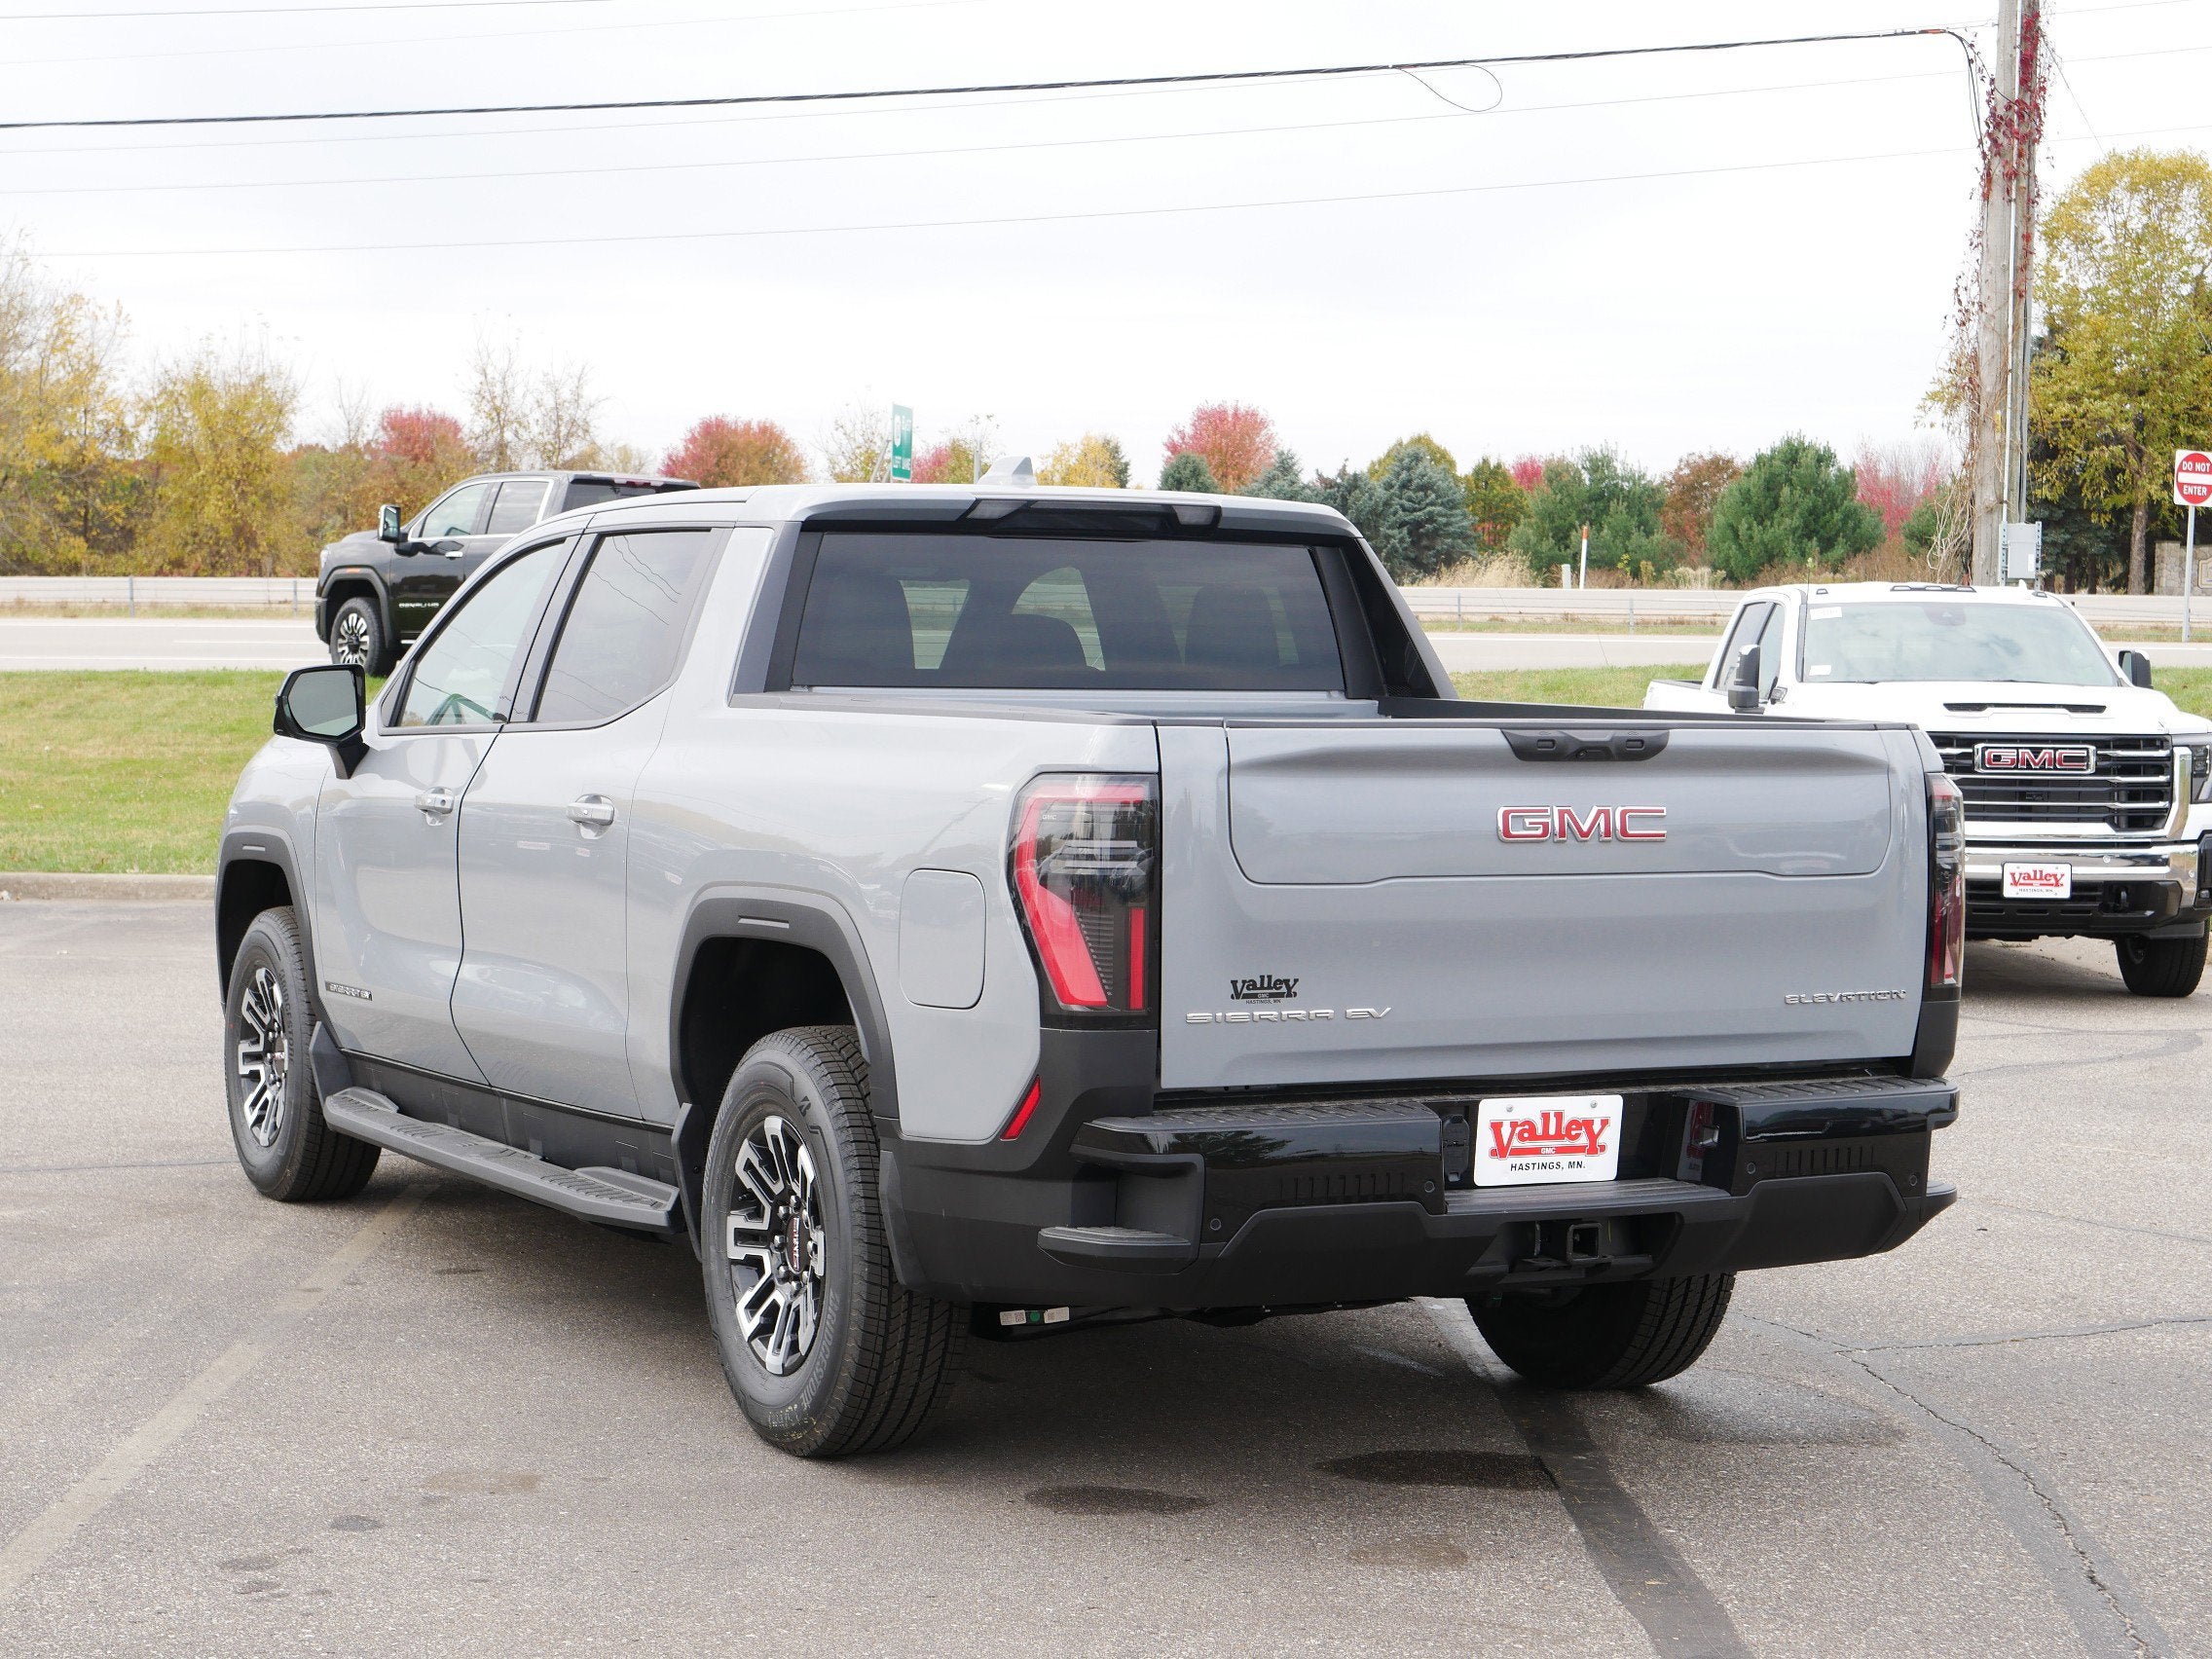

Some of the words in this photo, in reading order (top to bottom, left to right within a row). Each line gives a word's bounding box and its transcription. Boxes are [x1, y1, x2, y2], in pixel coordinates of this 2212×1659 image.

[2182, 461, 2193, 471] DO
[2194, 461, 2210, 472] NOT
[2183, 485, 2207, 497] ENTER
[1984, 748, 2087, 770] GMC
[1496, 805, 1668, 843] GMC
[1785, 989, 1907, 1005] ELEVATION
[1186, 1009, 1335, 1023] SIERRA
[1345, 1007, 1392, 1020] EV
[1510, 1161, 1565, 1171] HASTINGS,
